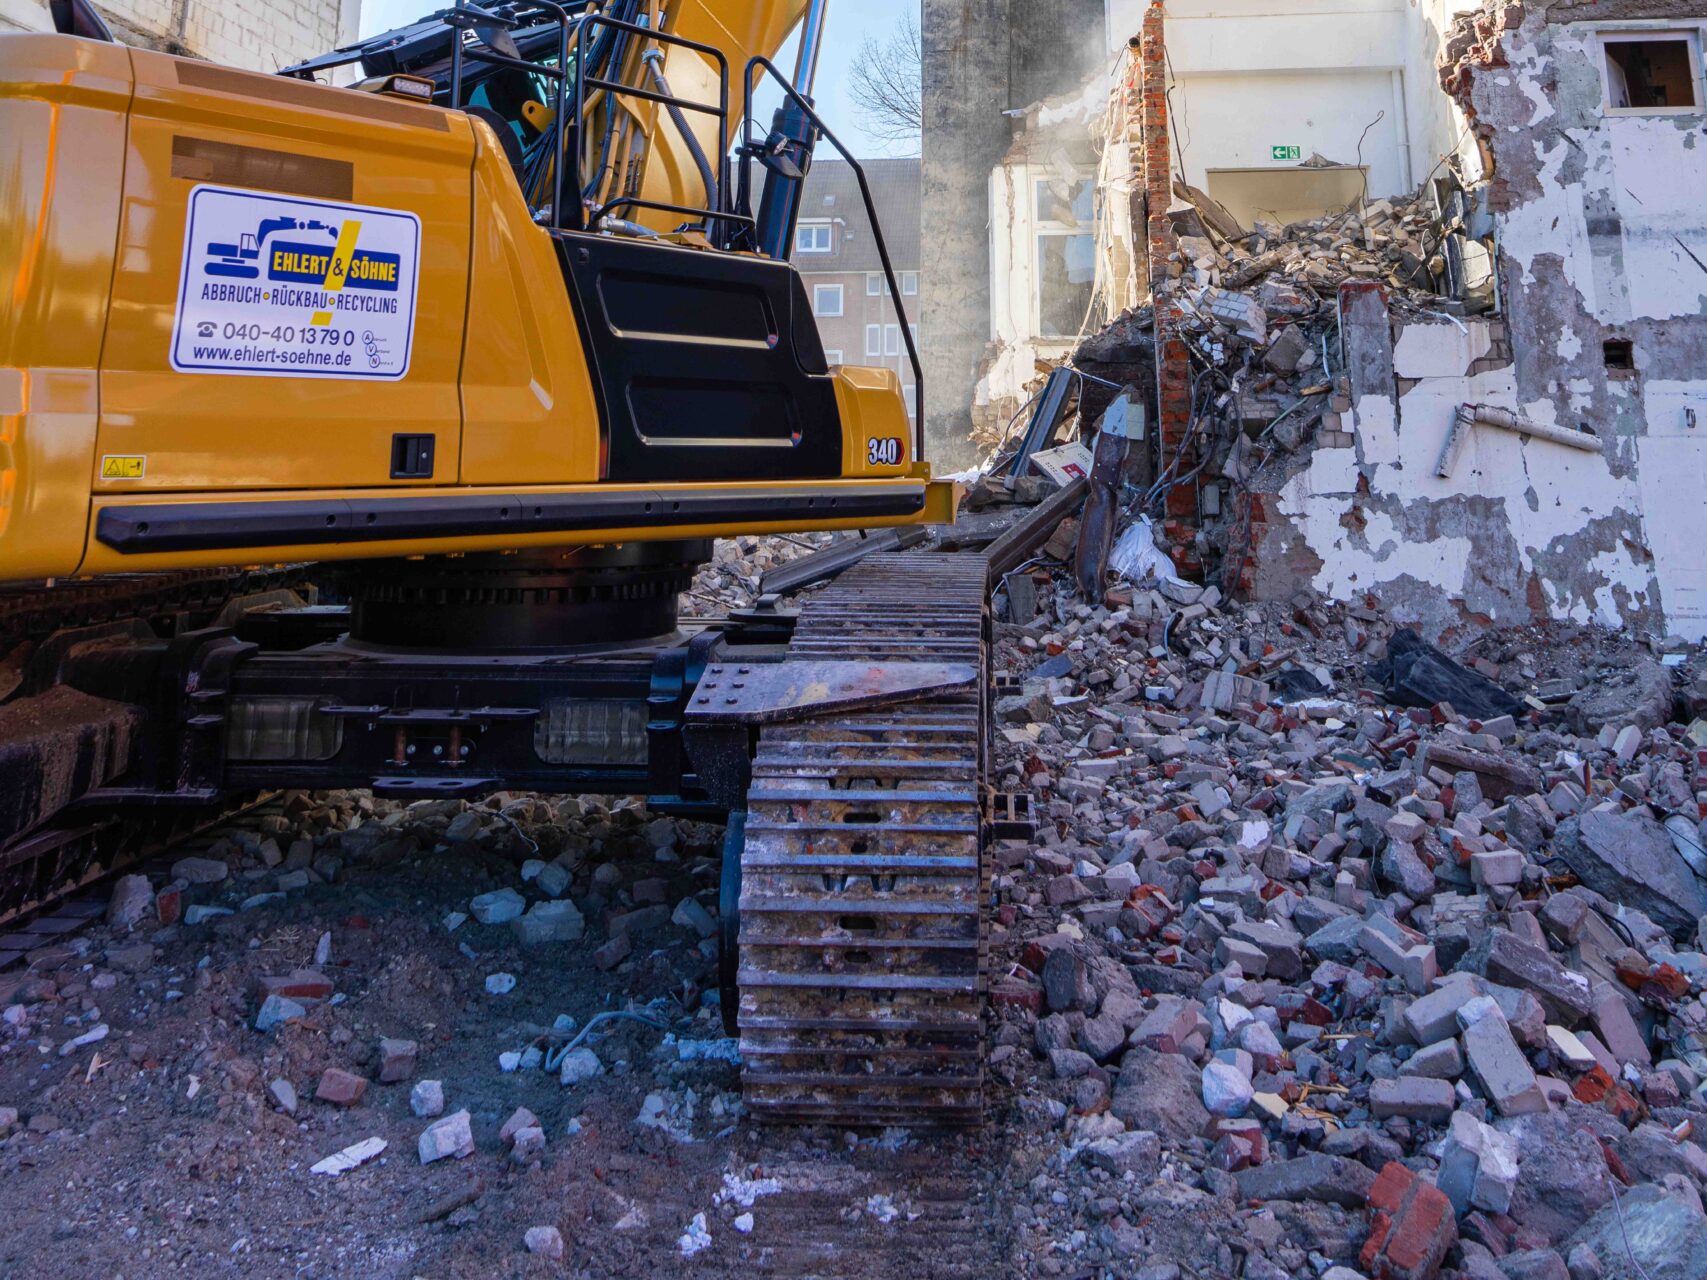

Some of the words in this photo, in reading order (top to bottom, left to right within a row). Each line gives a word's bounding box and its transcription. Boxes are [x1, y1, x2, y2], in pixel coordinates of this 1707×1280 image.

[273, 251, 329, 275] EHLERT
[332, 257, 345, 277] &
[351, 256, 397, 282] SÖHNE
[201, 283, 261, 304] ABBRUCH
[271, 285, 328, 309] RÜCKBAU
[336, 294, 398, 314] RECYCLING
[222, 322, 295, 343] 040-40
[193, 345, 352, 367] www.ehlert-soehne.de
[868, 437, 897, 466] 340
